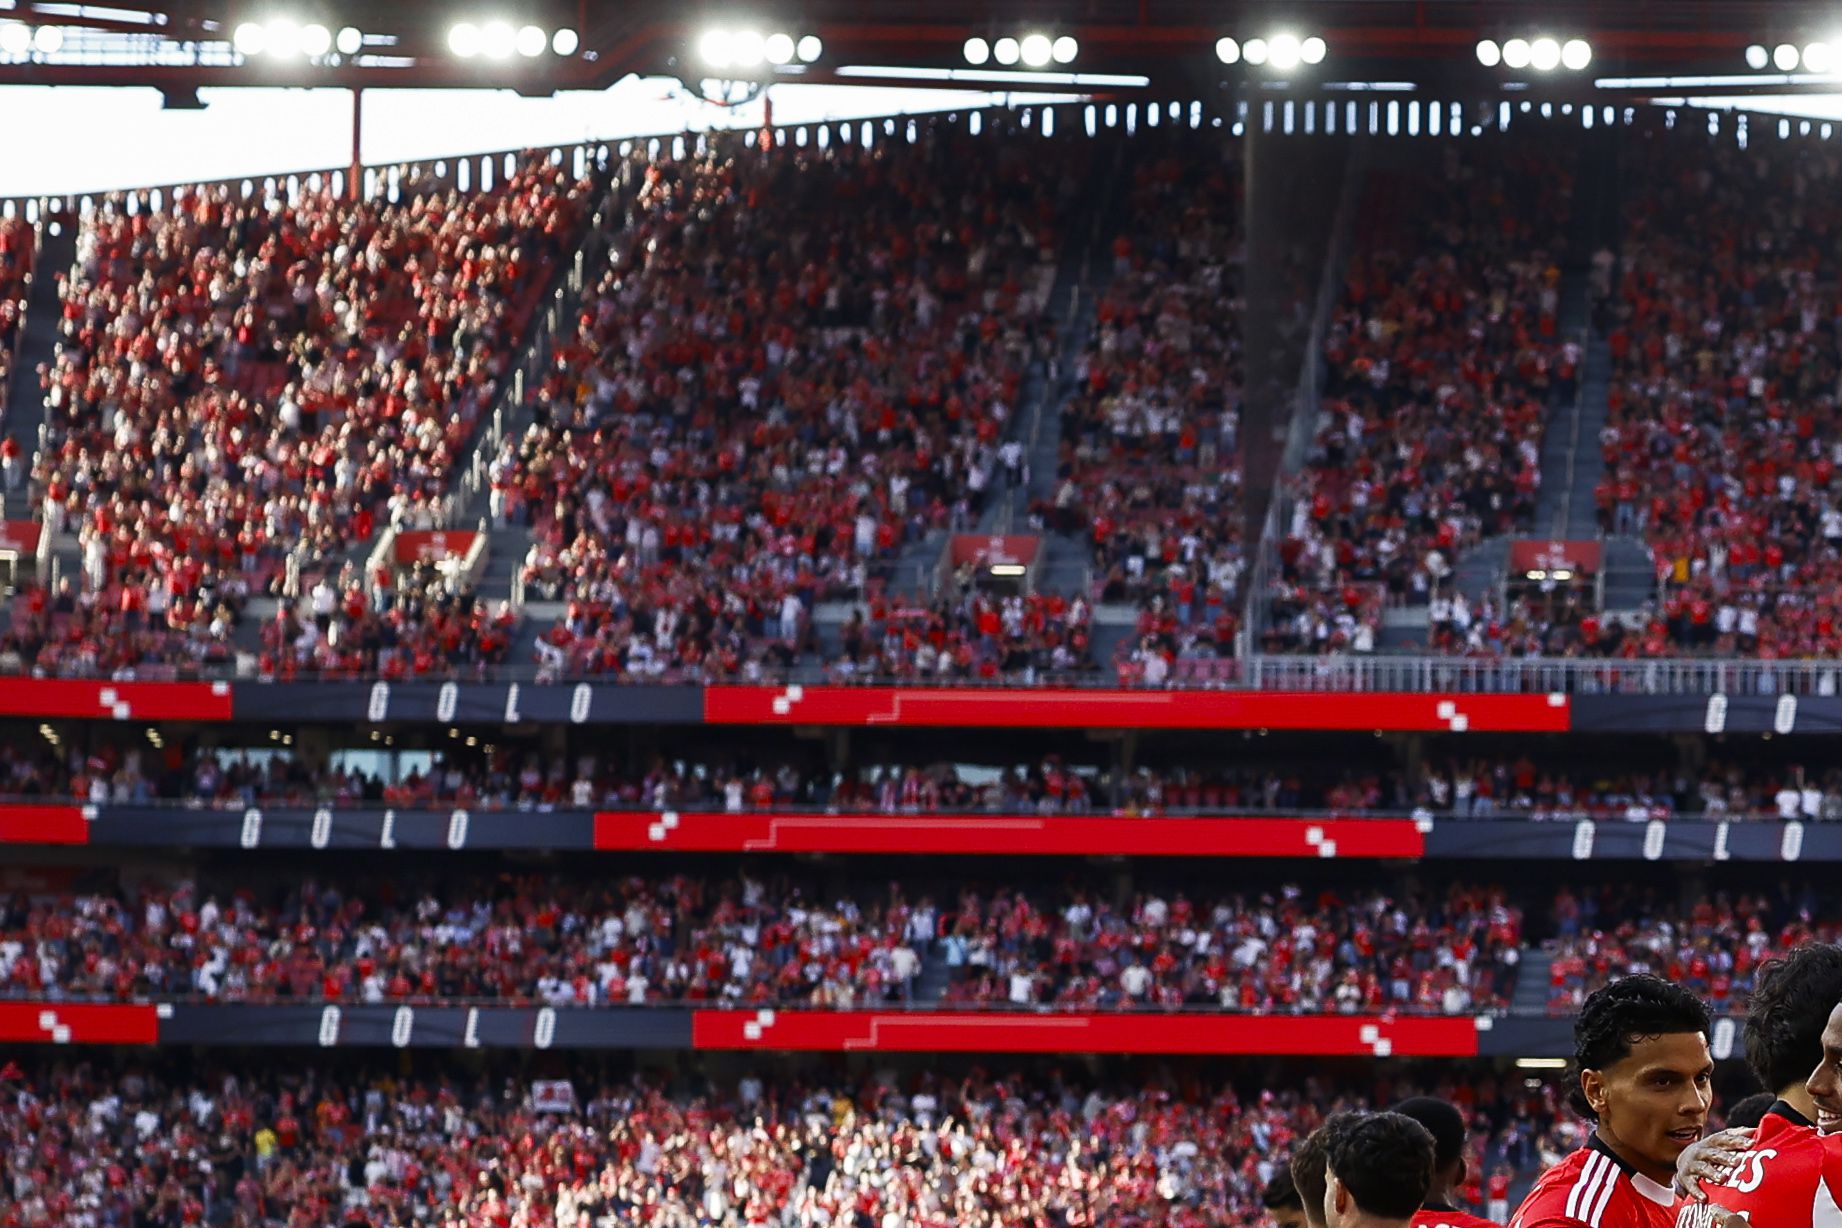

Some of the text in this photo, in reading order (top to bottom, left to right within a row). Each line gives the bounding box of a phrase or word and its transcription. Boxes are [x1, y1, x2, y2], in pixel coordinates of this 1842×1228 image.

[368, 681, 593, 724] GOLO
[241, 808, 469, 850] GOLO
[1572, 819, 1804, 861] GOLO
[318, 1005, 557, 1048] GOLO
